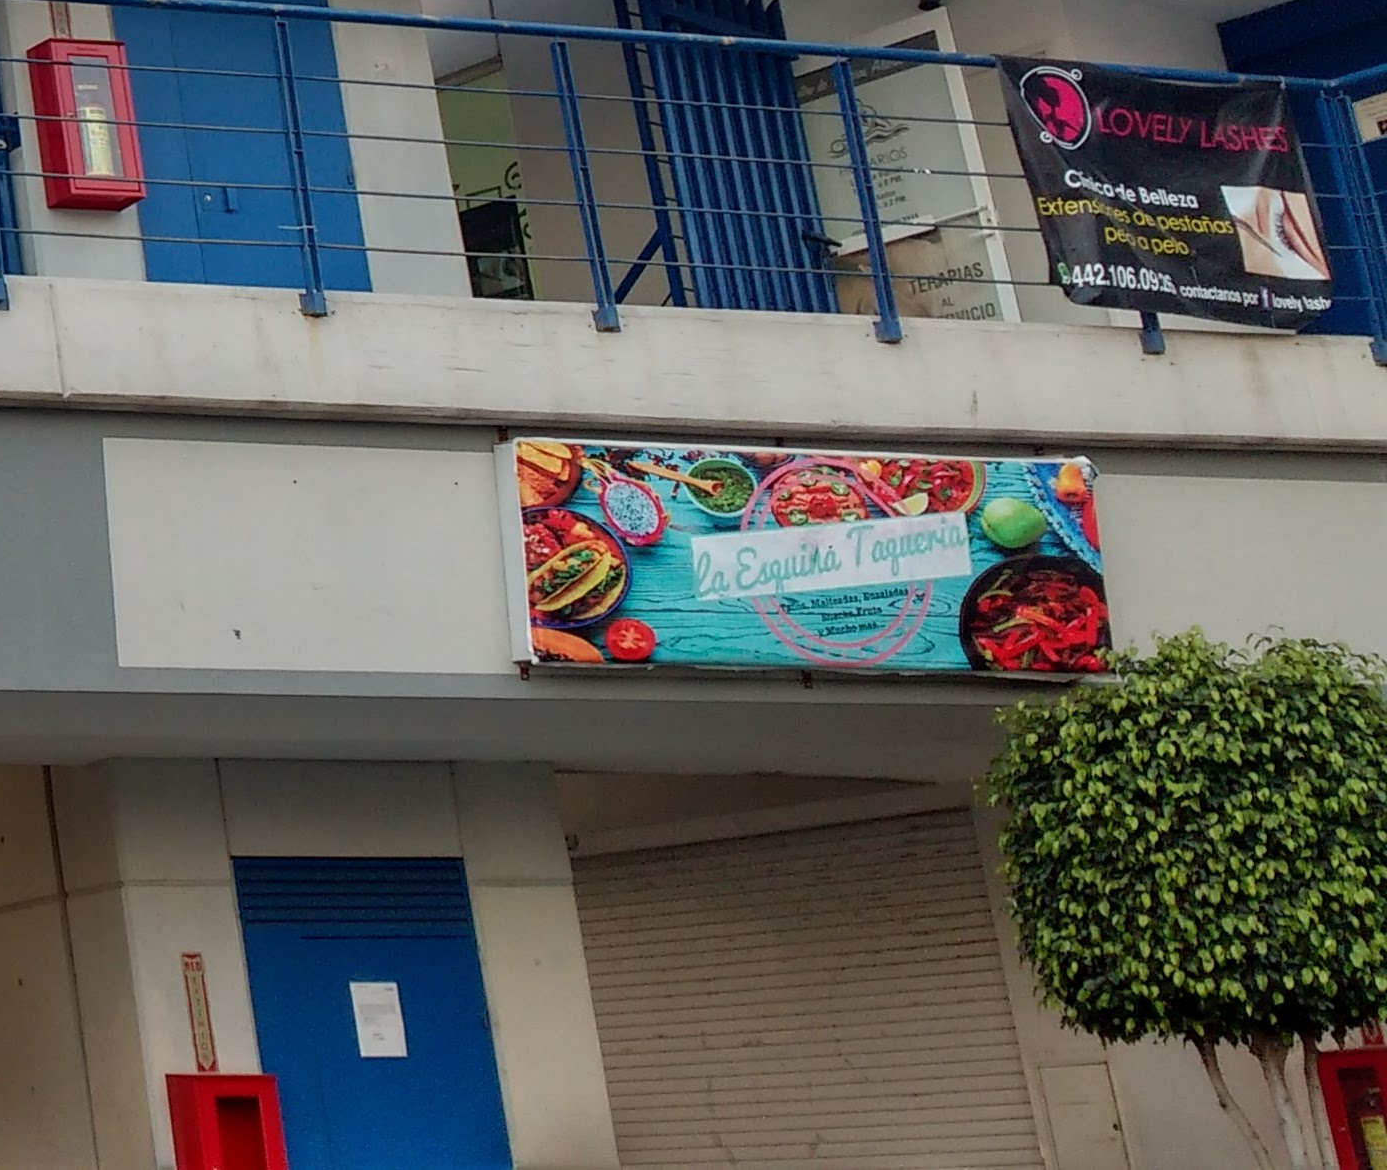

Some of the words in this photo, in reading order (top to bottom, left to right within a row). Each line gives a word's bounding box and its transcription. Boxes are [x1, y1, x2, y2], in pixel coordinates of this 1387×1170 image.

[1094, 106, 1193, 145] LOVELY
[1199, 121, 1289, 153] LASHES
[1115, 183, 1137, 202] de
[1138, 185, 1199, 209] Belleza
[1132, 208, 1156, 227] de
[1155, 211, 1235, 235] pestañas
[1137, 234, 1149, 250] a
[1151, 235, 1190, 255] pelo
[908, 262, 984, 296] TERAPIAS
[937, 302, 996, 321] VICIO
[942, 296, 954, 307] AL
[1243, 291, 1259, 308] por
[1272, 292, 1303, 312] lovely
[735, 542, 842, 593] Esquina
